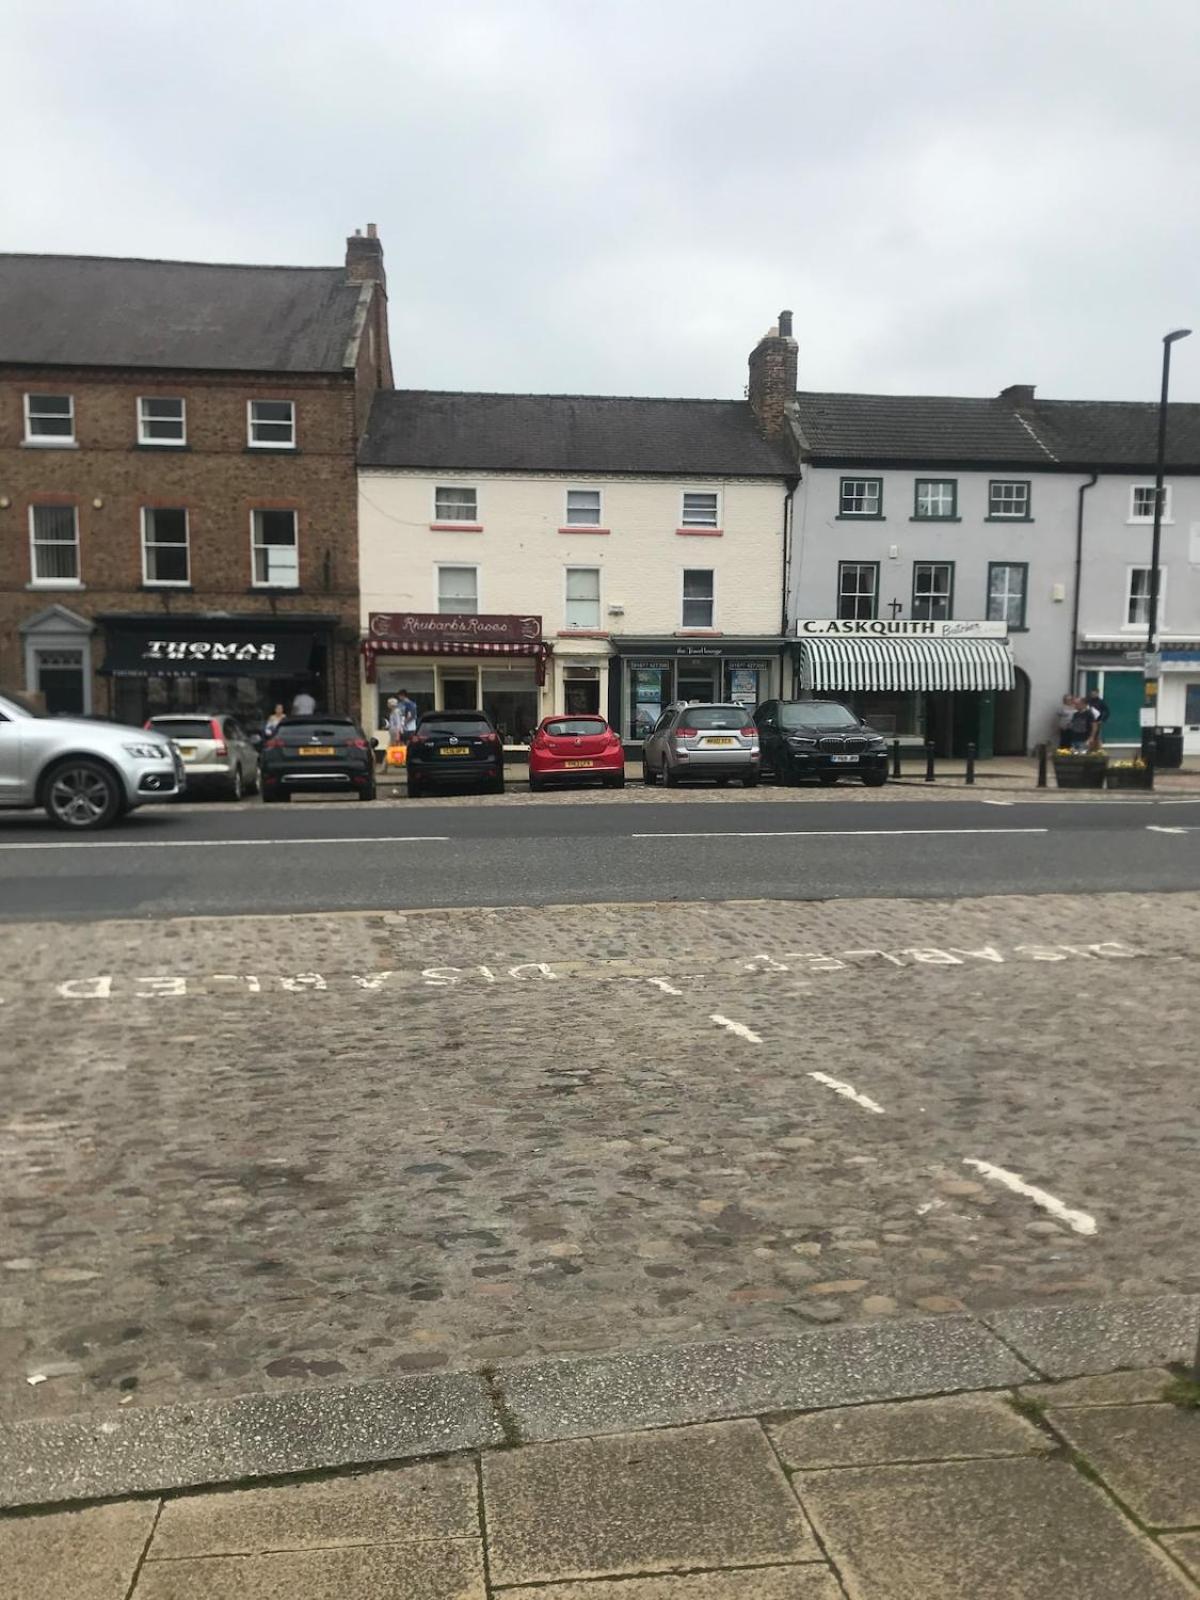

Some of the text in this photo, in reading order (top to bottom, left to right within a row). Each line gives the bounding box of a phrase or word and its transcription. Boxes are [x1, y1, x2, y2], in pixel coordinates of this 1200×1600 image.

[402, 617, 459, 633] Rhubarb
[466, 618, 508, 634] Roses
[148, 641, 276, 653] THOMAS
